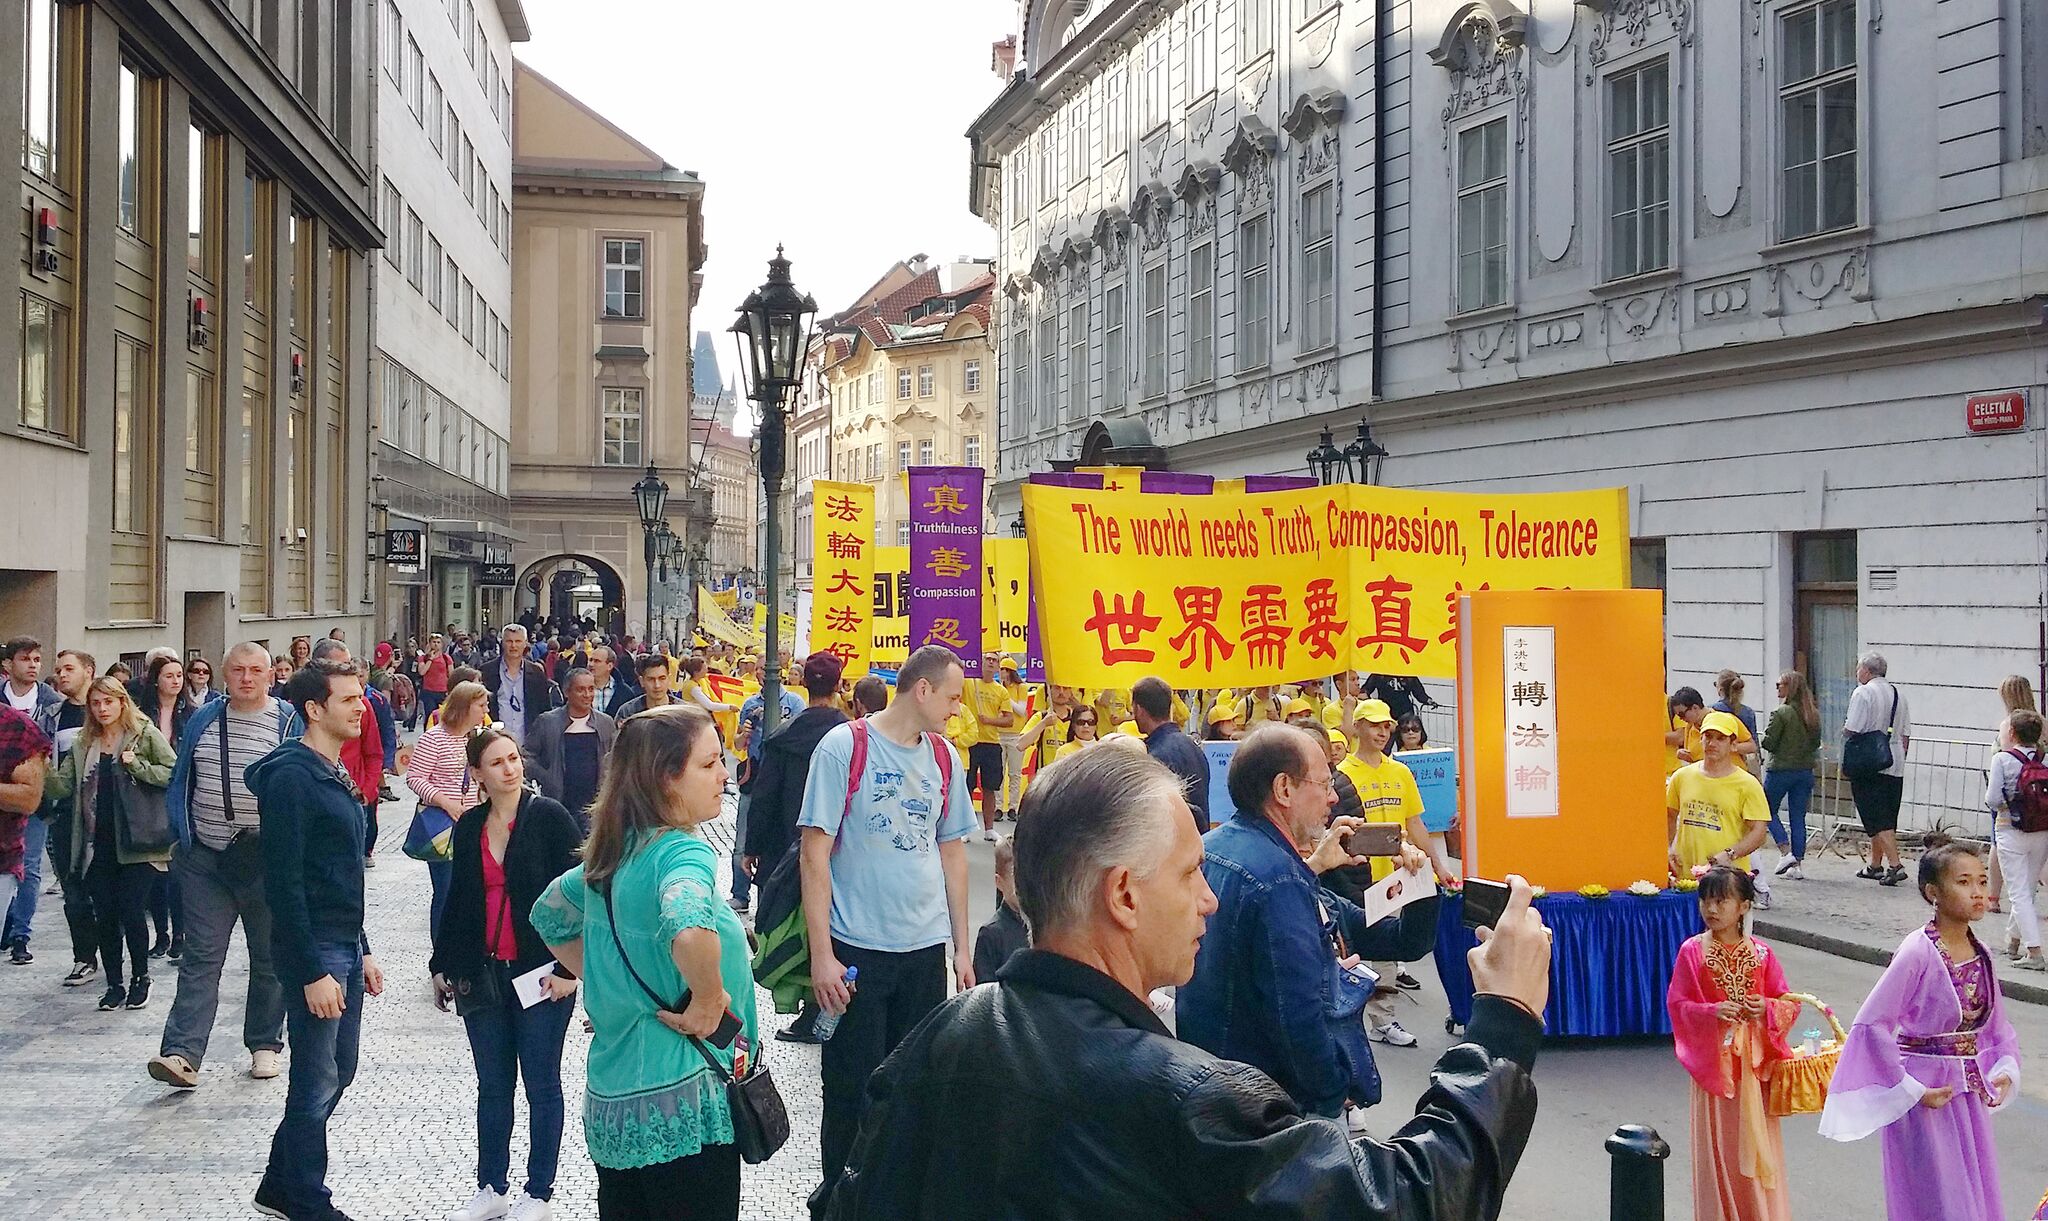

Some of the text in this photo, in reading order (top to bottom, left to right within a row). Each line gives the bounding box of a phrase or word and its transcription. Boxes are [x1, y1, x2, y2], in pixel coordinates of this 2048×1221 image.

[1975, 398, 2012, 416] CELETNÁ
[923, 485, 969, 514] 真
[913, 521, 978, 536] Truthfulness
[1071, 499, 1598, 567] The world needs Truth, Compassion, Tolerance
[486, 566, 510, 574] JOY
[925, 545, 972, 578] 善
[913, 586, 976, 600] Compassion
[871, 621, 1028, 648] uma Hop
[922, 617, 970, 649] 忍
[1084, 574, 1572, 673] 世界需要真
[1513, 637, 1529, 672] 李洪志
[1511, 680, 1551, 791] 轉法輪
[1427, 756, 1451, 764] FALUN
